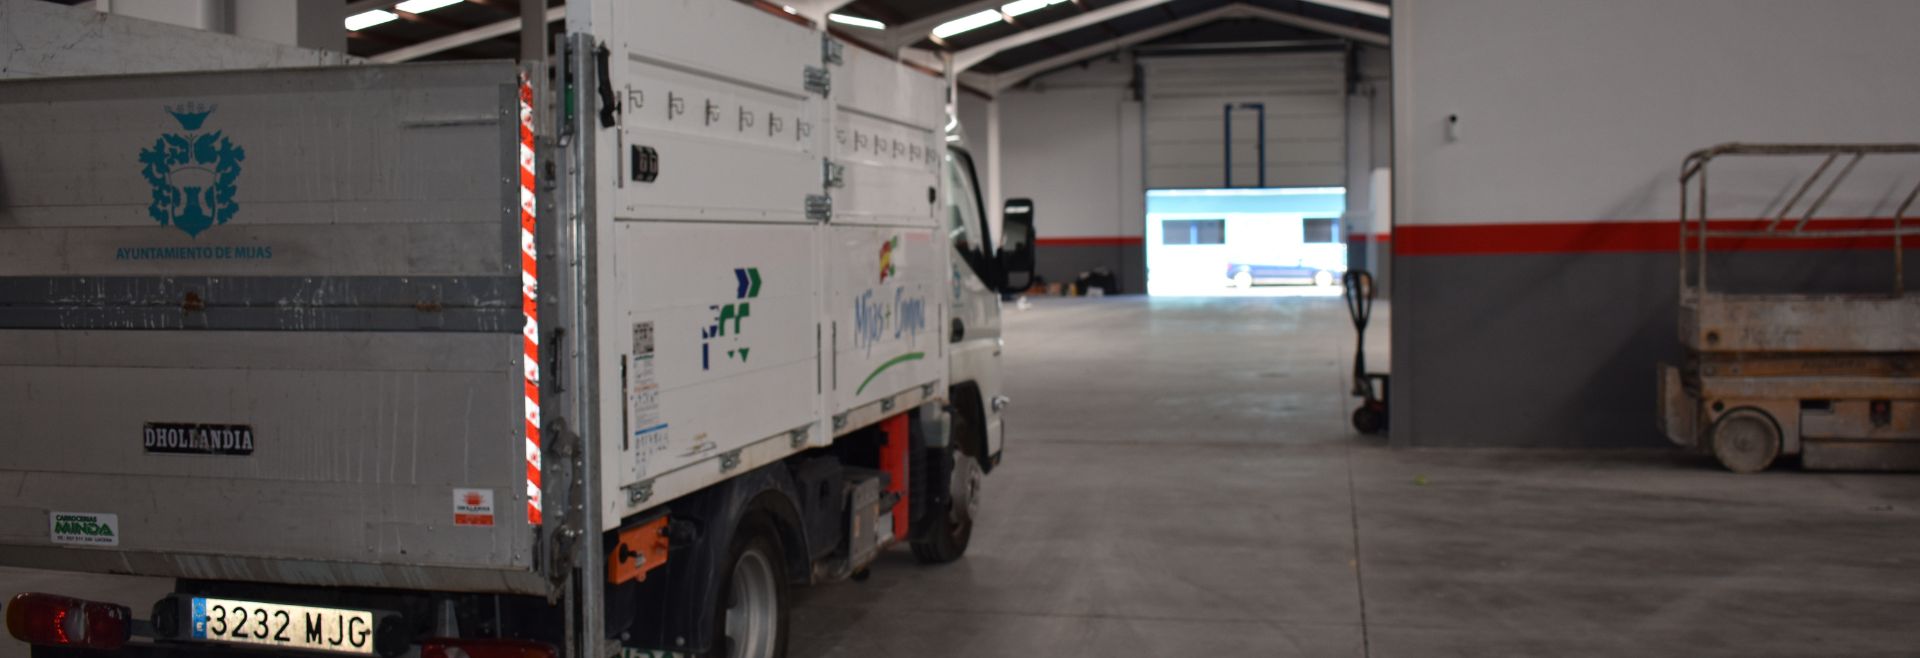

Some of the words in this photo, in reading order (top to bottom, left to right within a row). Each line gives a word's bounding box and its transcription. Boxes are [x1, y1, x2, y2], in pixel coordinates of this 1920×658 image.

[116, 247, 213, 260] AYUNTAMIENTO
[215, 246, 233, 259] DE
[235, 246, 272, 259] MIJAS
[55, 521, 115, 536] MINDA
[196, 622, 203, 632] E
[211, 605, 291, 642] 3232
[305, 612, 367, 648] MJG
